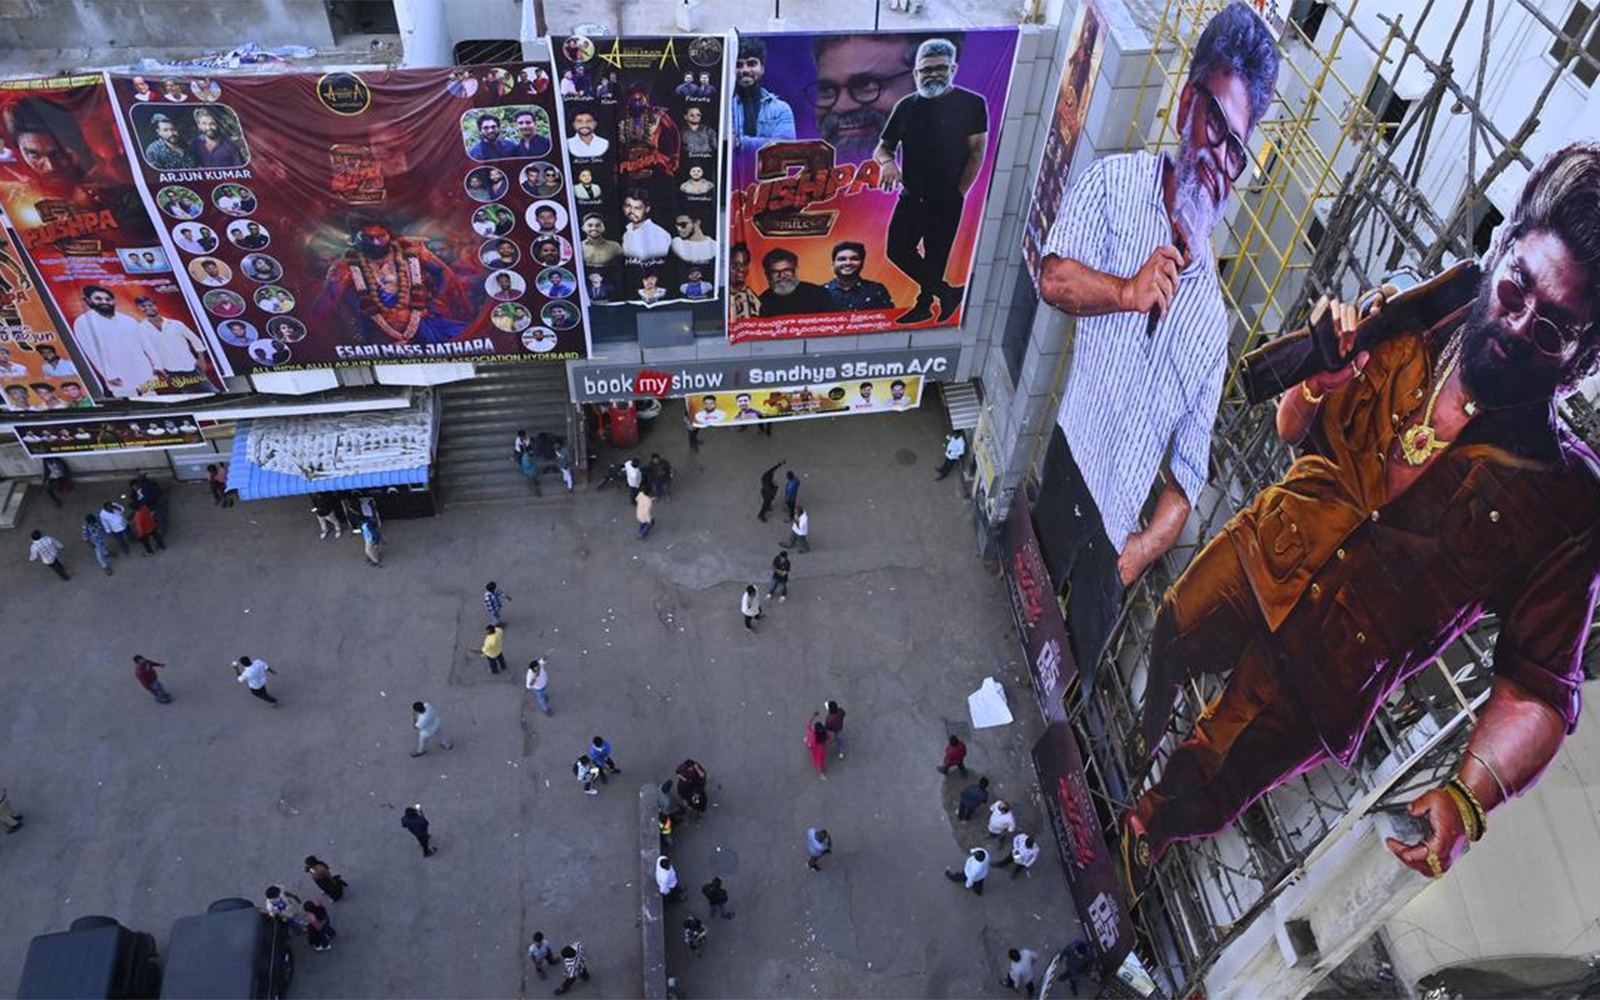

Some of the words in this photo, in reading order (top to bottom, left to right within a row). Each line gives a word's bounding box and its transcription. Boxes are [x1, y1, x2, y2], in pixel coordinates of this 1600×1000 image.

[159, 172, 203, 183] ARJUN
[204, 169, 252, 180] KUMAR
[381, 342, 422, 357] MASS
[426, 337, 495, 356] JATHARA
[584, 374, 633, 395] book
[639, 376, 668, 395] my
[671, 370, 724, 390] show
[749, 364, 837, 384] Sandhya
[841, 361, 904, 378] 35mm
[907, 356, 948, 374] A/C
